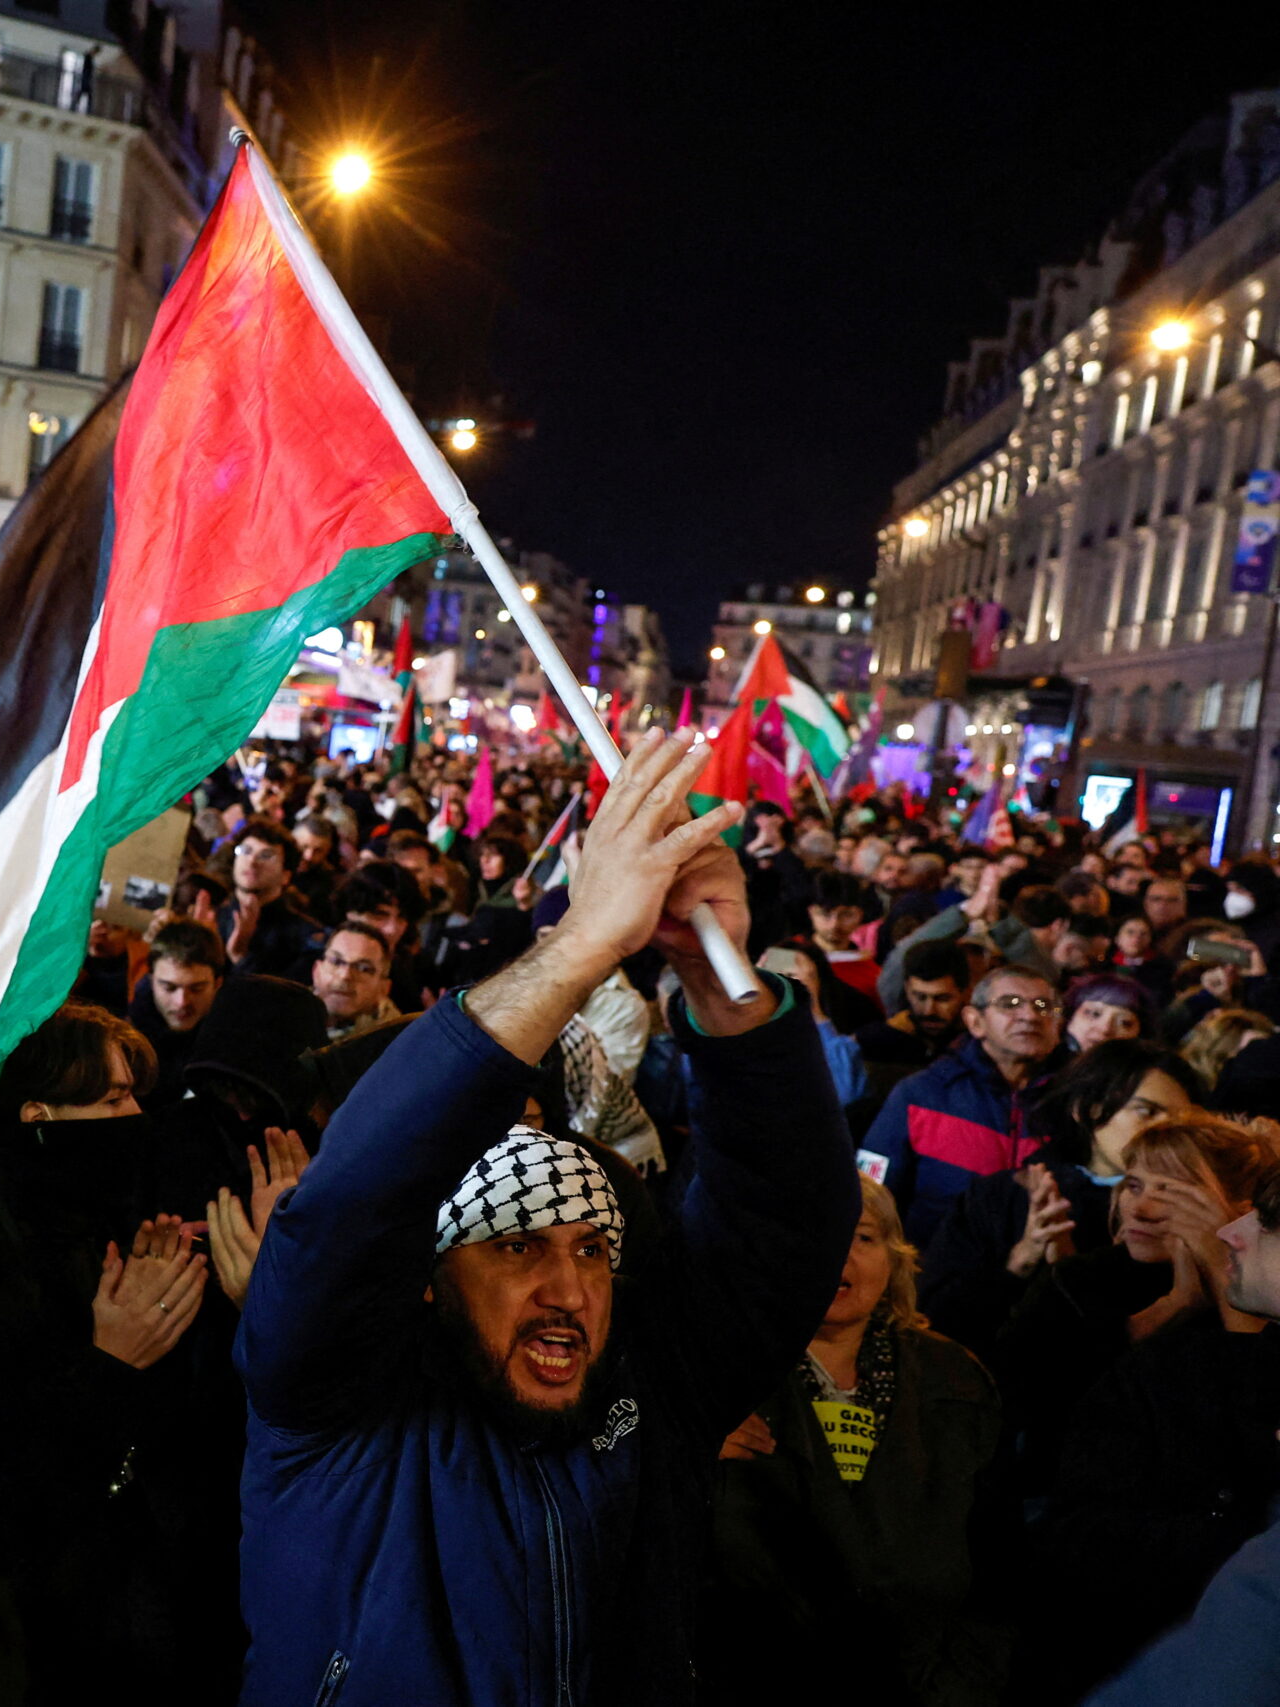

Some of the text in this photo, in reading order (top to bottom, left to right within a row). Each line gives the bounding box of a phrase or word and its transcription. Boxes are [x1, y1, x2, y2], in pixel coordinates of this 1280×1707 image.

[840, 1409, 874, 1426] GAZ
[824, 1421, 878, 1441] U SECO
[829, 1442, 870, 1457] SILEN
